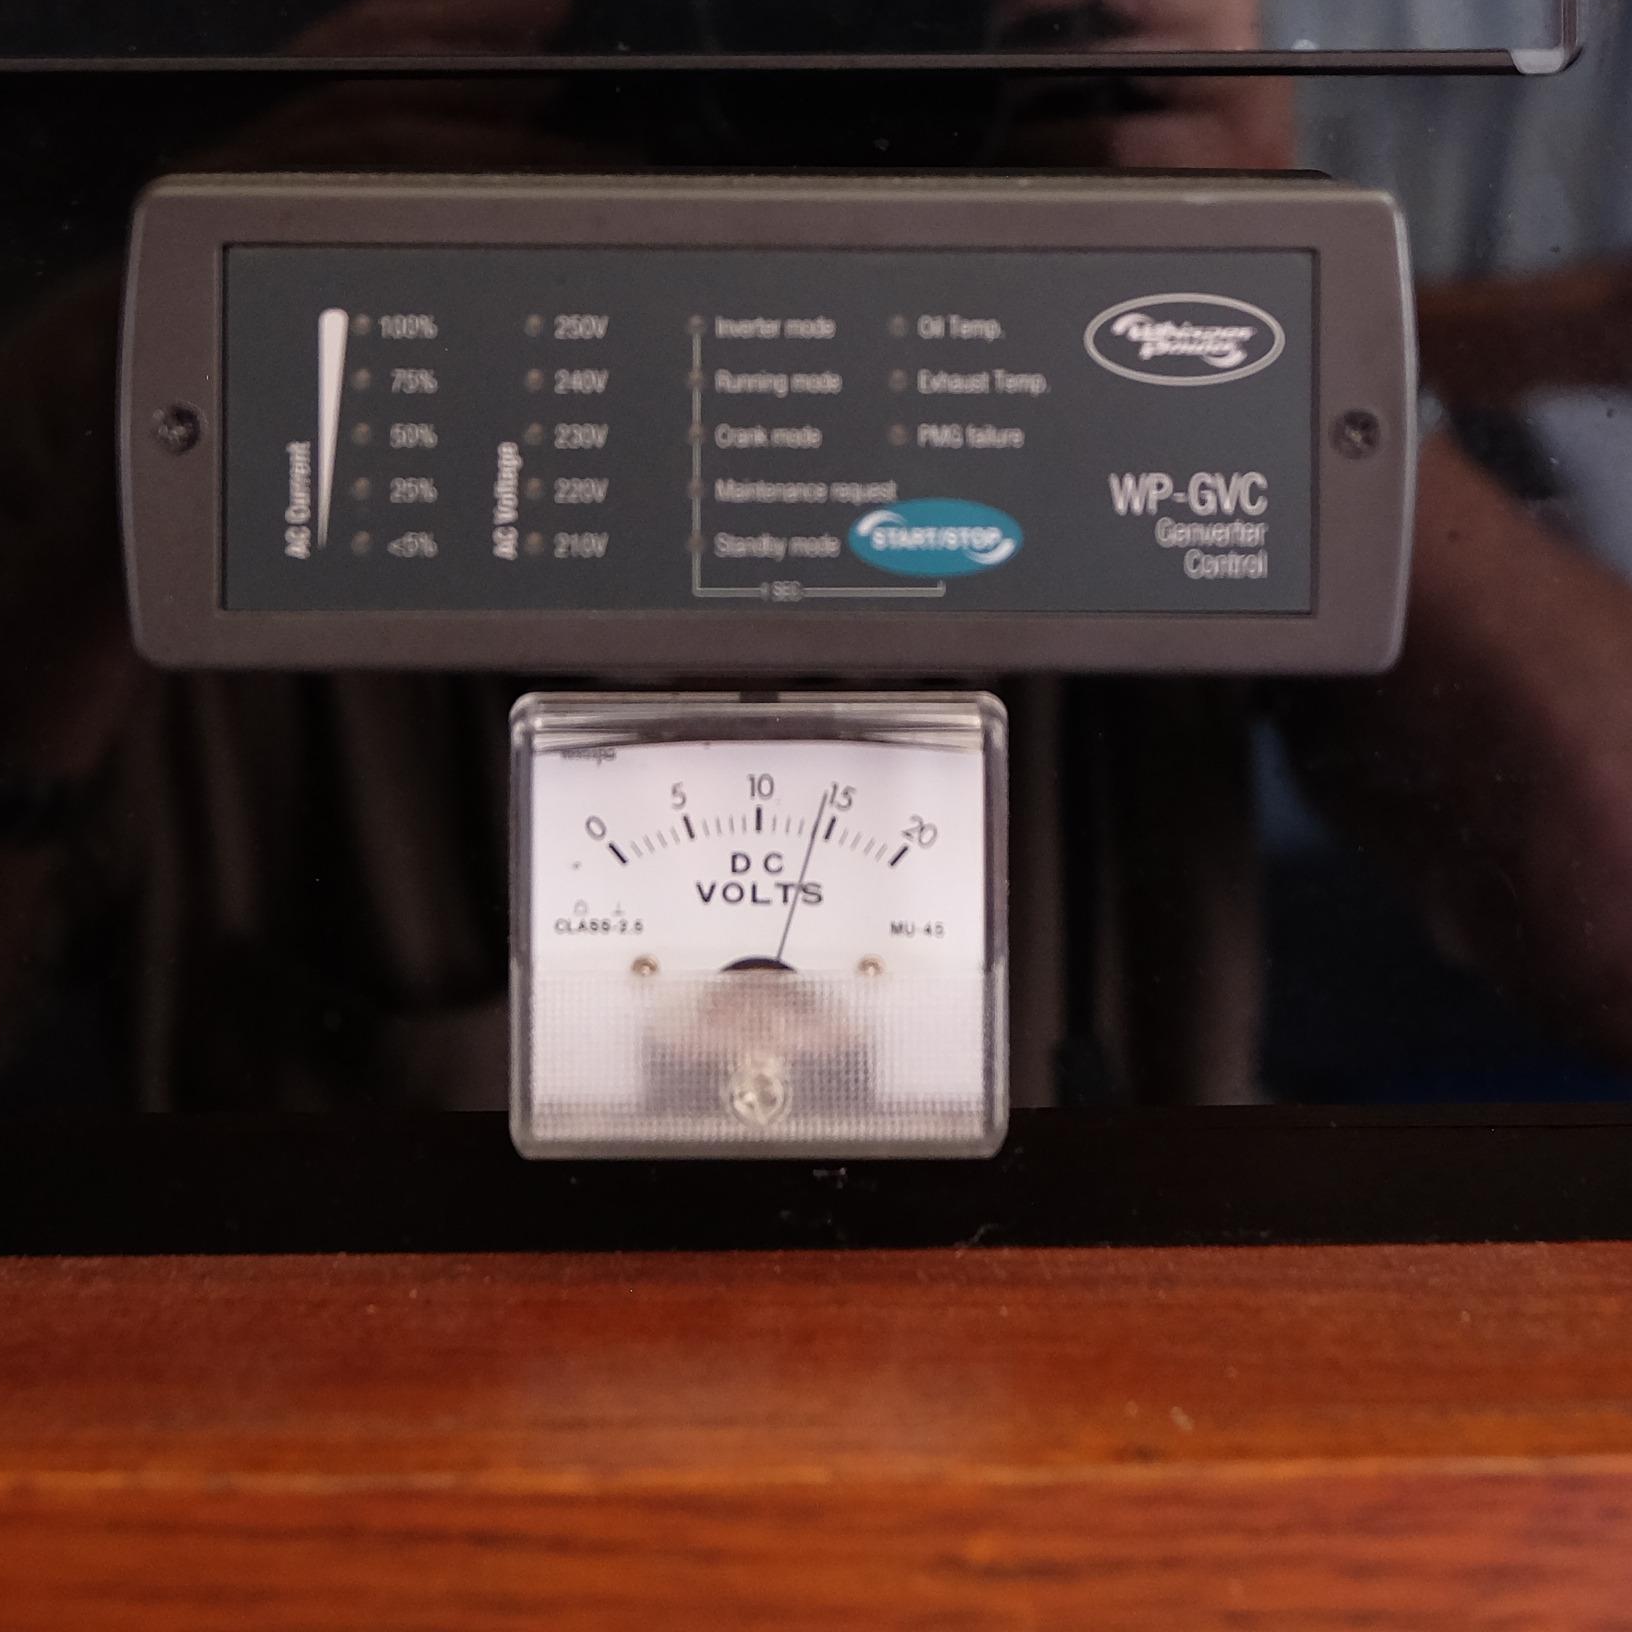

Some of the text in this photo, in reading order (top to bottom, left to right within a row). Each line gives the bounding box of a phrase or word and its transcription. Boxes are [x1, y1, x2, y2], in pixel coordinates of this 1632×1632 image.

[378, 314, 438, 339] 100%
[554, 314, 609, 339] 250V
[715, 316, 836, 339] Inverter mode
[918, 315, 945, 339] Oil
[391, 368, 438, 394] 75%
[554, 368, 609, 394] 240V
[715, 369, 843, 398] Running mode
[918, 368, 990, 394] Exhaust
[390, 423, 438, 449] 50%
[554, 423, 609, 449] 230V
[715, 422, 823, 449] Crank mode
[965, 423, 1025, 449] failure
[285, 441, 311, 560] AC Current
[390, 477, 438, 503] 25%
[493, 441, 523, 560] AC Voltage
[554, 477, 609, 503] 220V
[715, 478, 897, 506] Maintenance request
[1108, 471, 1268, 516] WP-GVC
[554, 532, 609, 558] 210V
[715, 531, 841, 561] Standby mode
[870, 525, 1003, 550] START/STOP
[1184, 548, 1268, 579] Control
[671, 782, 687, 809] 5
[748, 773, 774, 800] 10
[829, 781, 857, 811] 15
[585, 815, 608, 841] 0
[901, 814, 938, 848] 20
[696, 882, 824, 905] VOLTS
